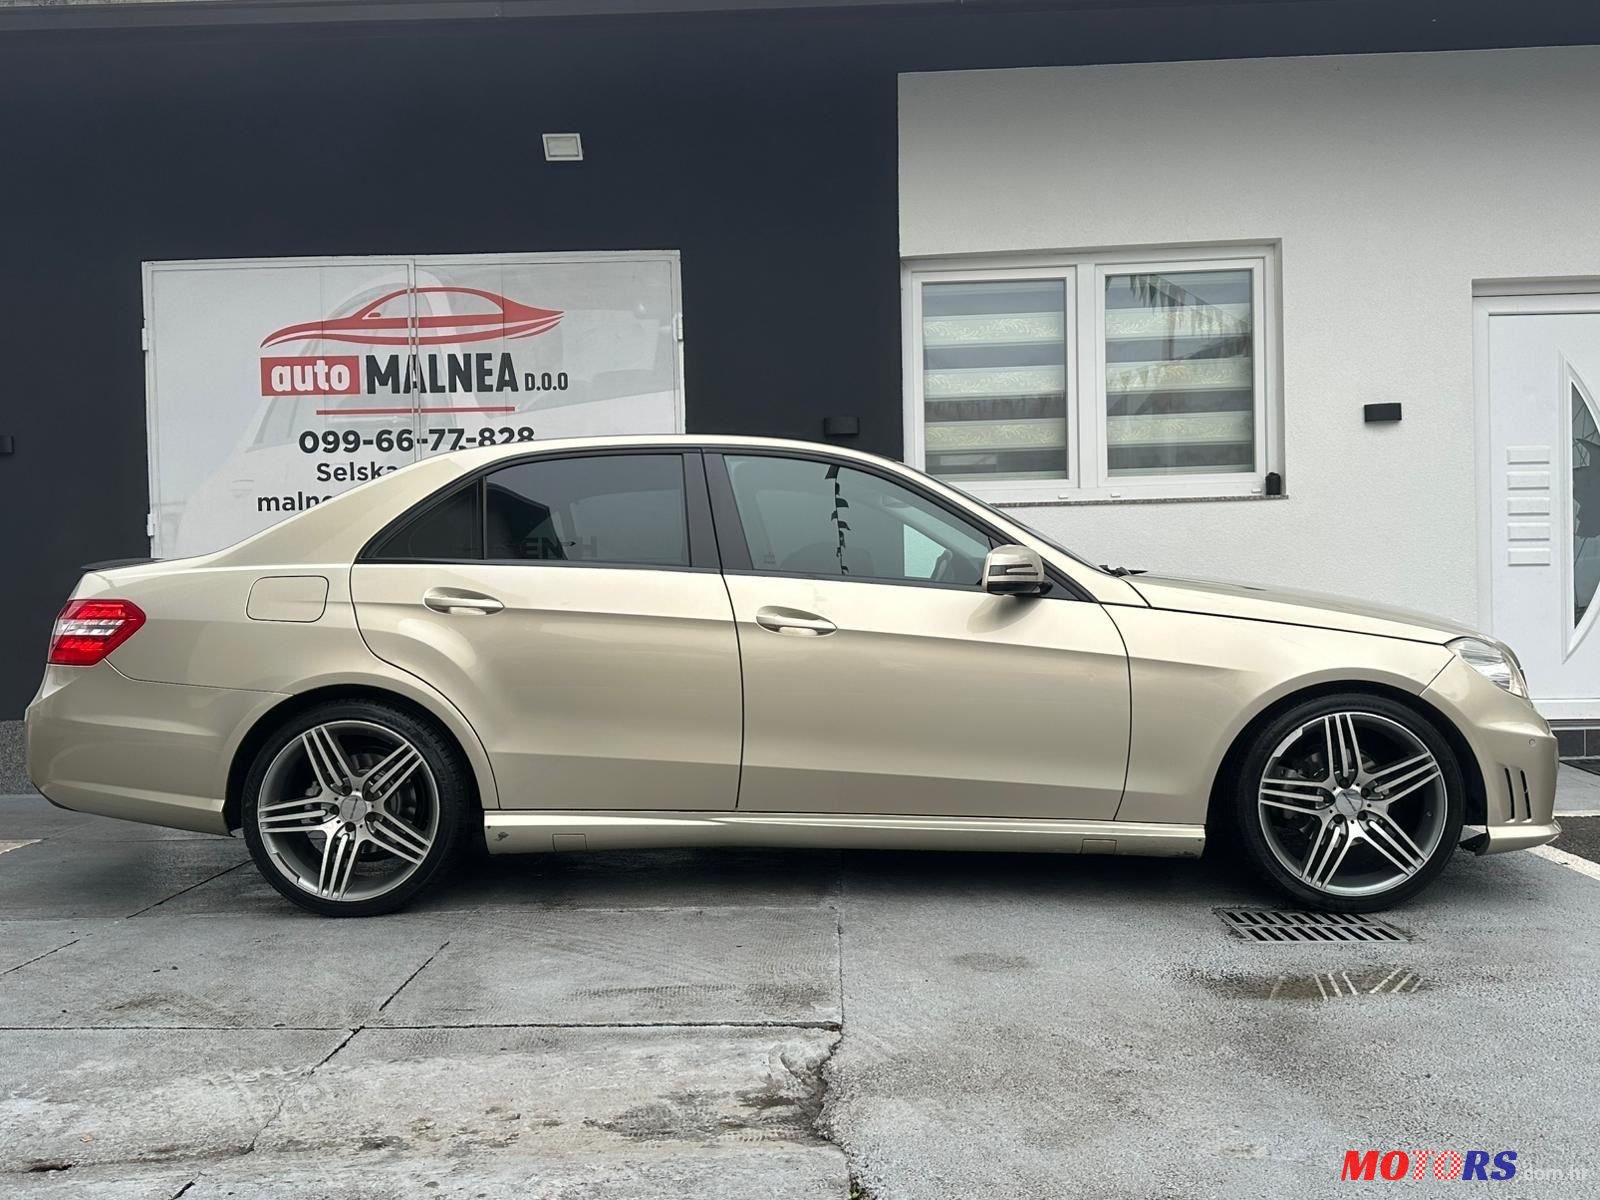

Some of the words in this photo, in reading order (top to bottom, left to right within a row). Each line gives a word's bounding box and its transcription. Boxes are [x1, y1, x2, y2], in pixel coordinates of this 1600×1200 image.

[271, 360, 350, 392] auto
[366, 352, 519, 394] MALNEA
[524, 371, 569, 392] D.O.O
